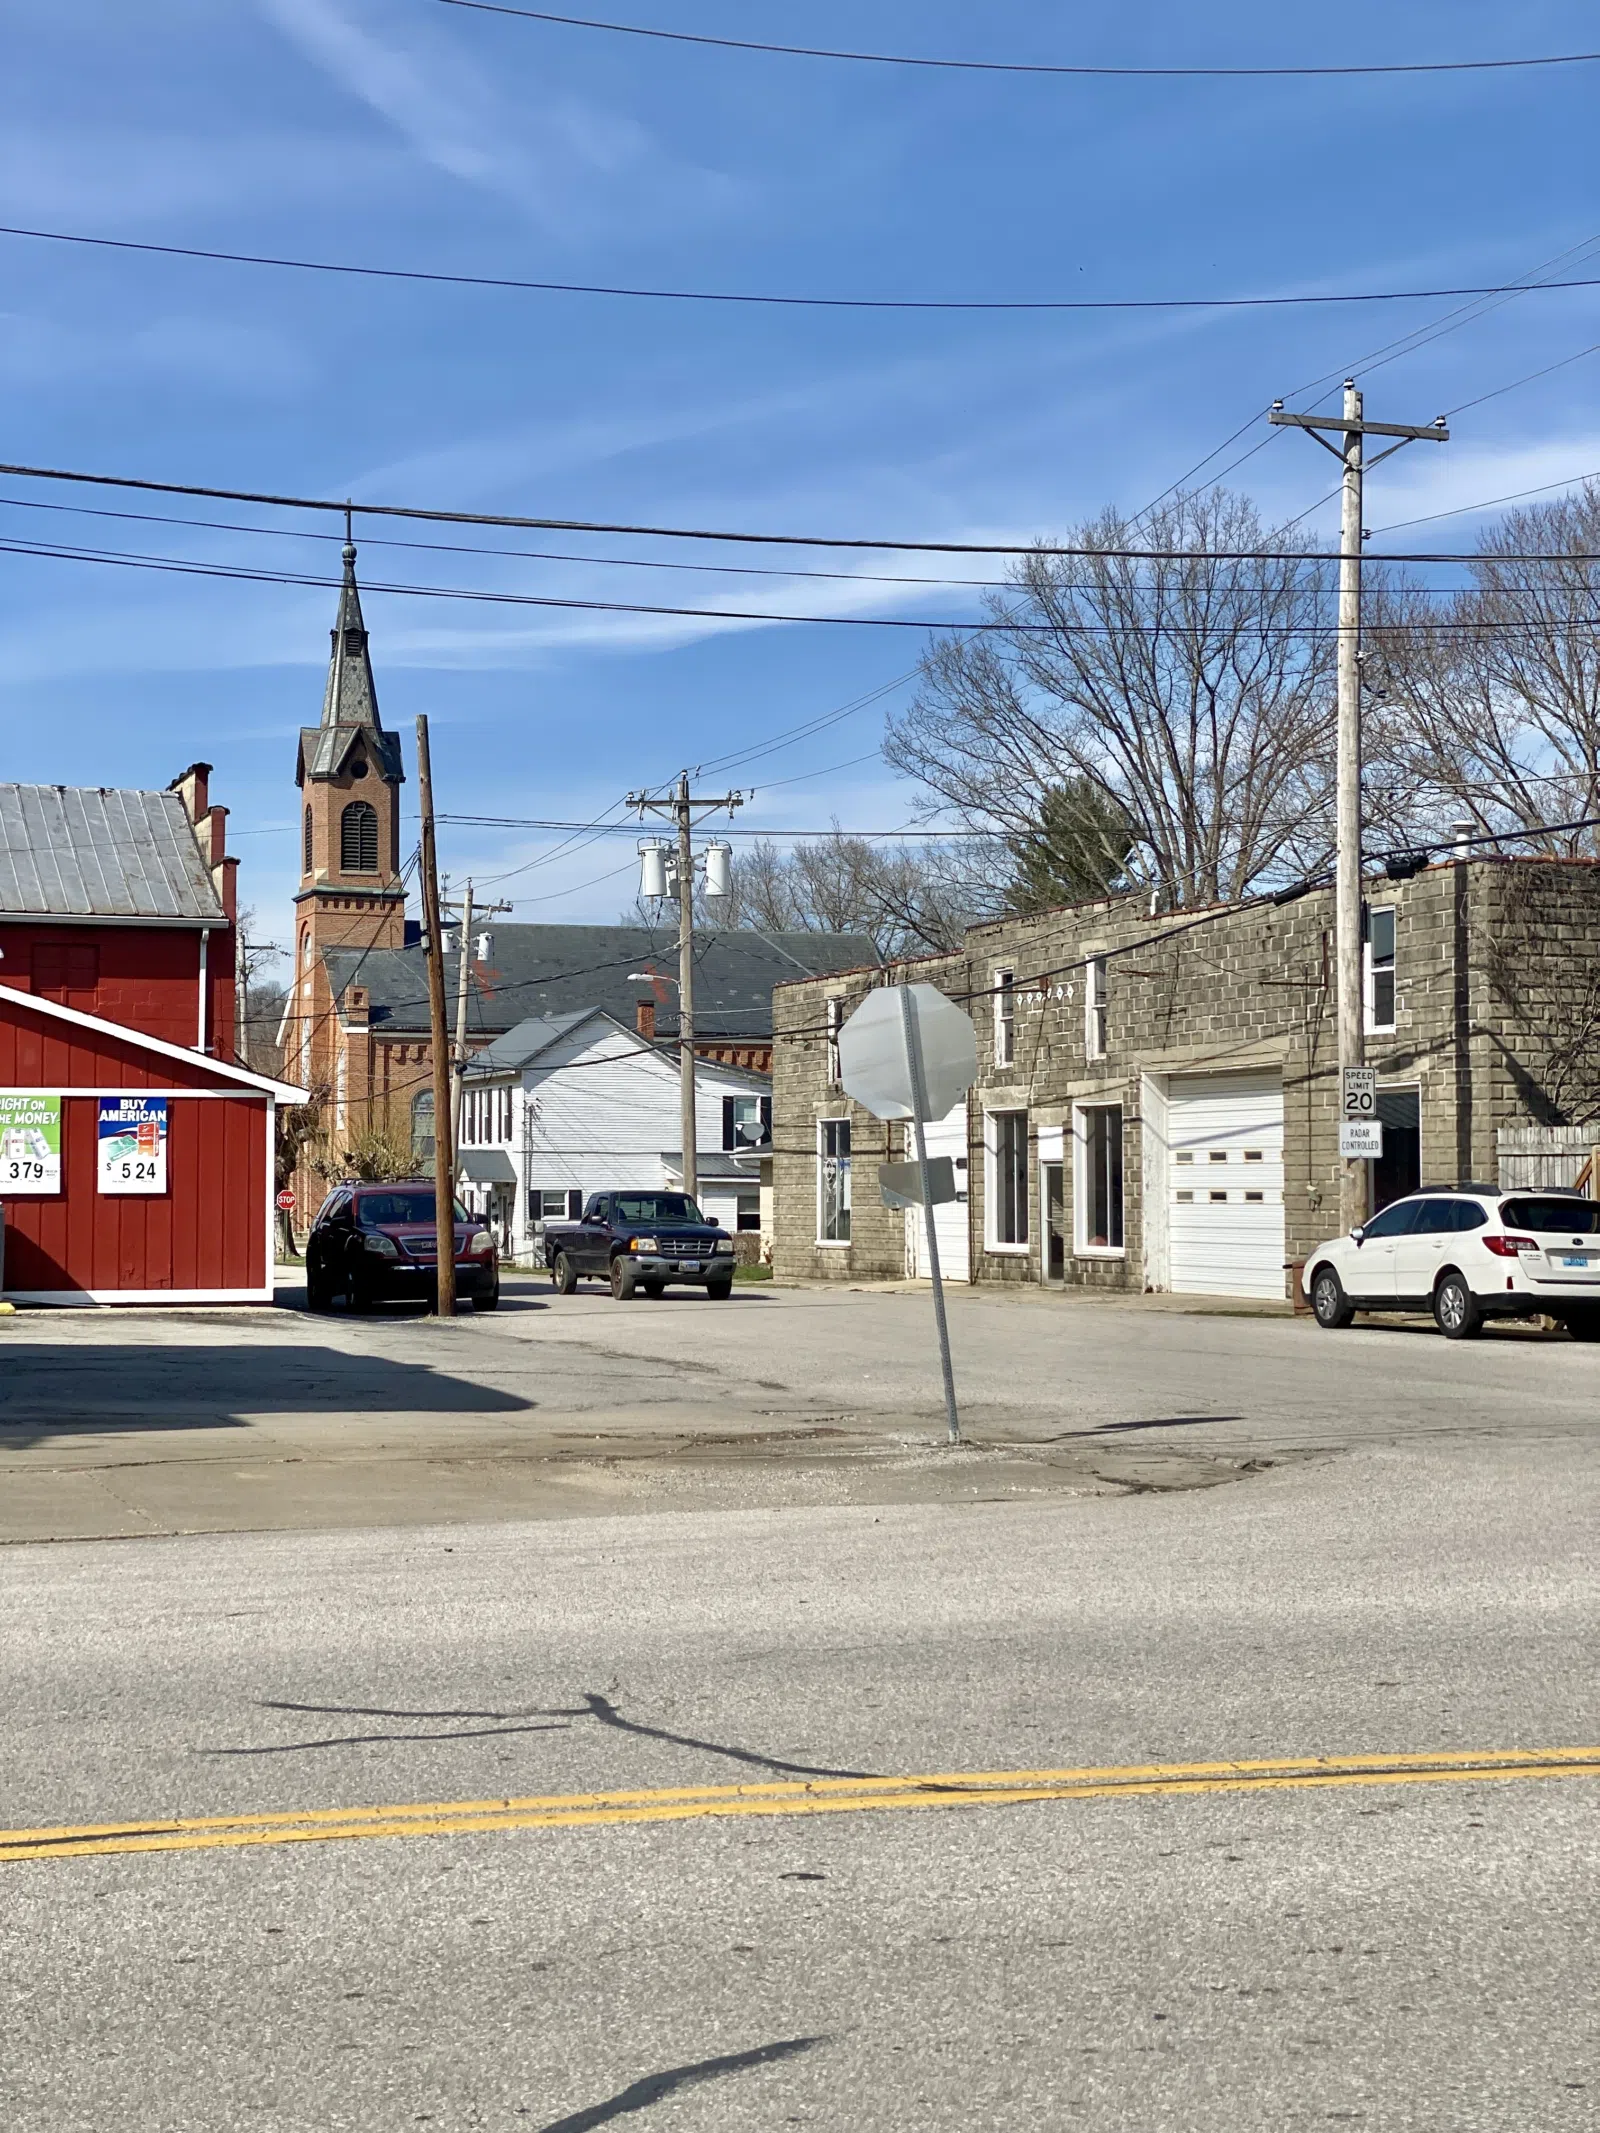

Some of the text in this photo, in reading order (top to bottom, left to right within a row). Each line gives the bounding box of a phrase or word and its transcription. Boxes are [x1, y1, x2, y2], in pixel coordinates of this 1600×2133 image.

[1345, 1071, 1373, 1080] SPEED
[1348, 1082, 1370, 1090] LIMIT
[0, 1098, 46, 1111] IGHT ON
[120, 1099, 148, 1110] BUY
[1346, 1092, 1373, 1110] 20
[0, 1112, 59, 1125] HE MONEY
[99, 1110, 167, 1122] AMERICAN
[1350, 1128, 1371, 1138] RADAR
[1341, 1140, 1379, 1151] CONTROLLED
[278, 1195, 295, 1204] STOP
